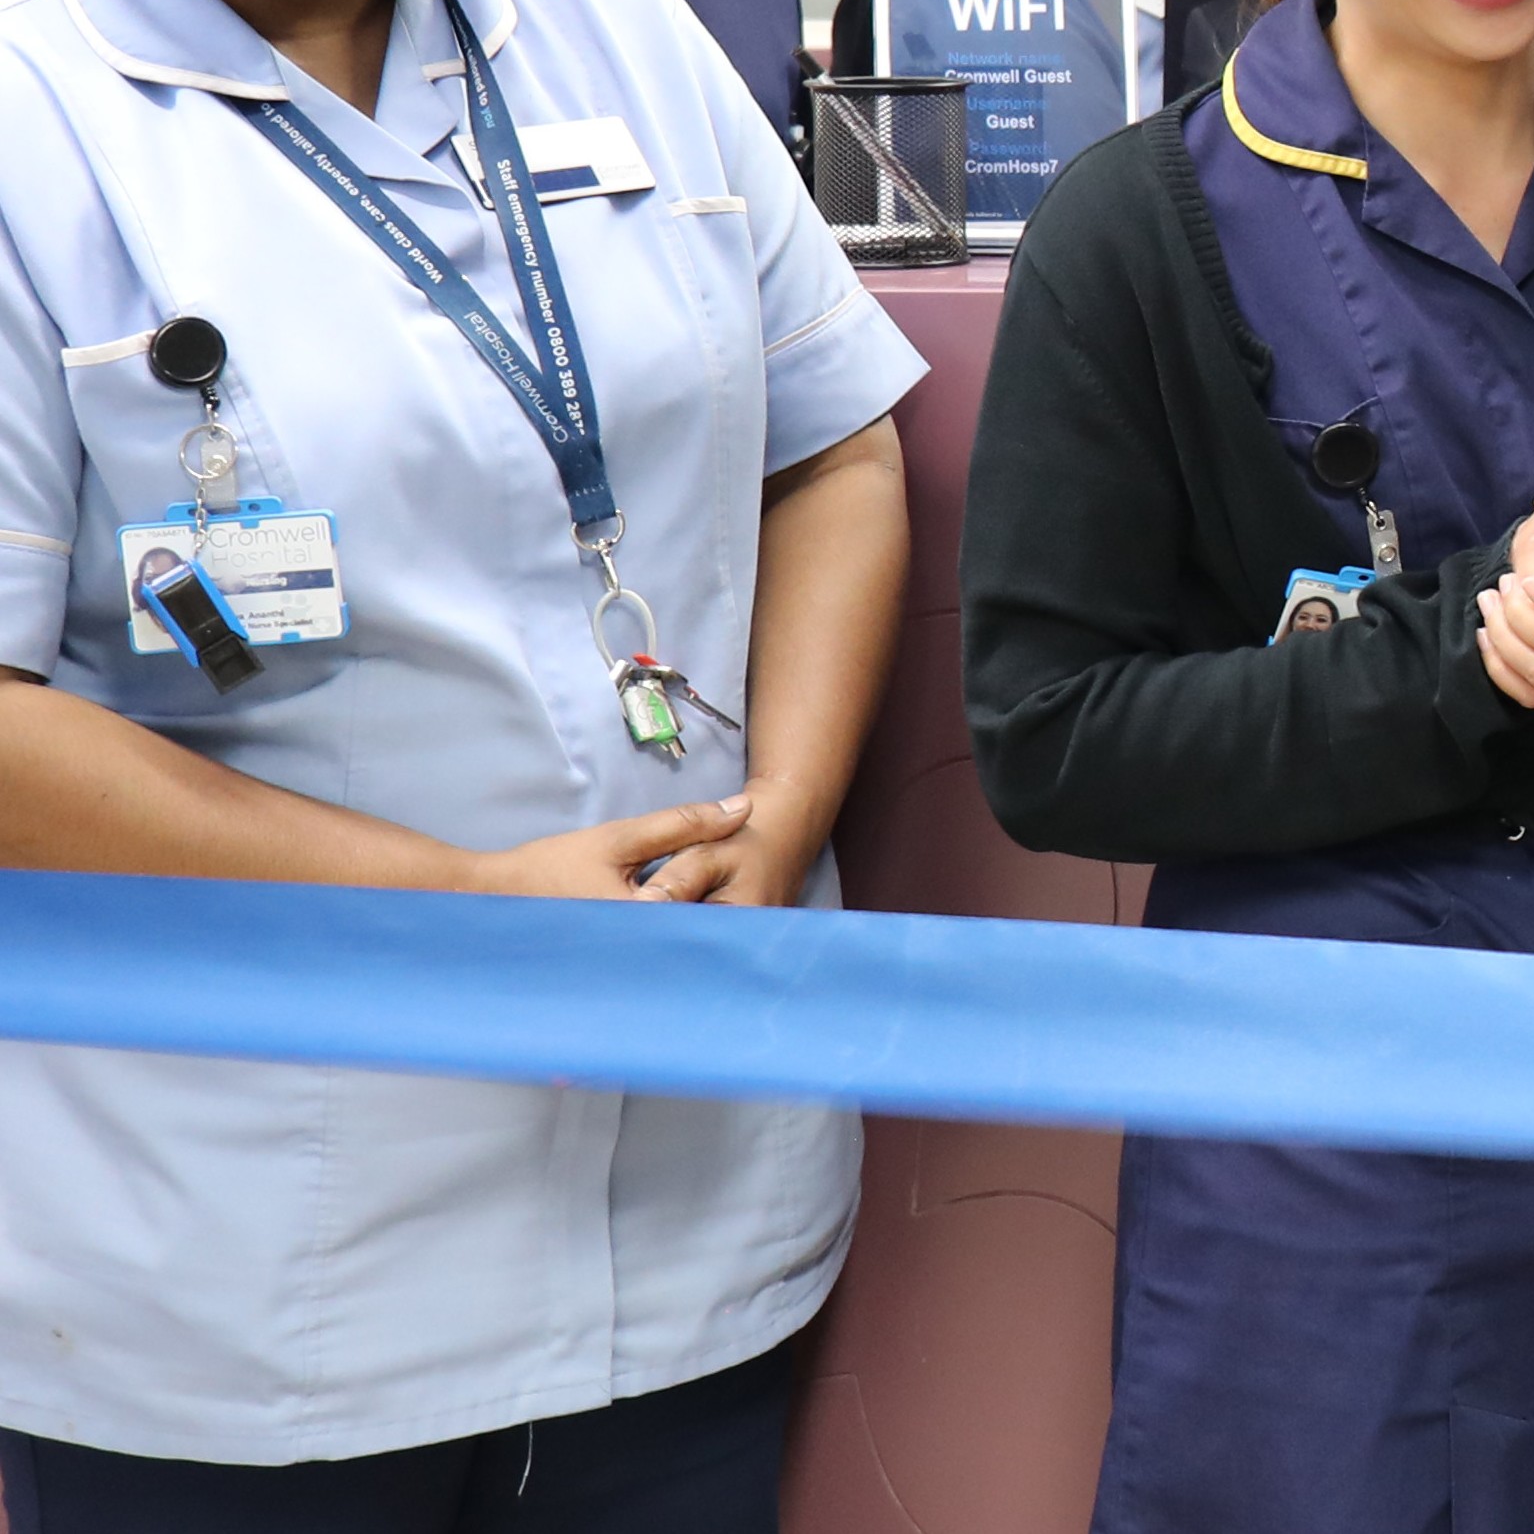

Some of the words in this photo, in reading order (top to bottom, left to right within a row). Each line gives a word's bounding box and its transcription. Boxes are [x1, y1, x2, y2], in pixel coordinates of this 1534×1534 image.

[947, 51, 1014, 66] Network
[1024, 68, 1073, 84] Guest
[260, 102, 276, 117] to
[480, 106, 497, 130] you
[985, 114, 1036, 129] Guest
[270, 113, 317, 157] tailored
[314, 152, 360, 197] expertly
[497, 159, 520, 191] Staff
[964, 159, 1059, 177] CromHosp7
[360, 194, 387, 225] care,
[383, 221, 413, 250] class
[507, 193, 539, 267] emergency
[407, 247, 445, 285] World
[531, 270, 556, 324] number
[463, 310, 520, 374] Hospital
[547, 327, 570, 368] 0800
[558, 369, 578, 398] 389
[511, 371, 569, 444] Cromwell
[209, 521, 328, 550] Cromwell
